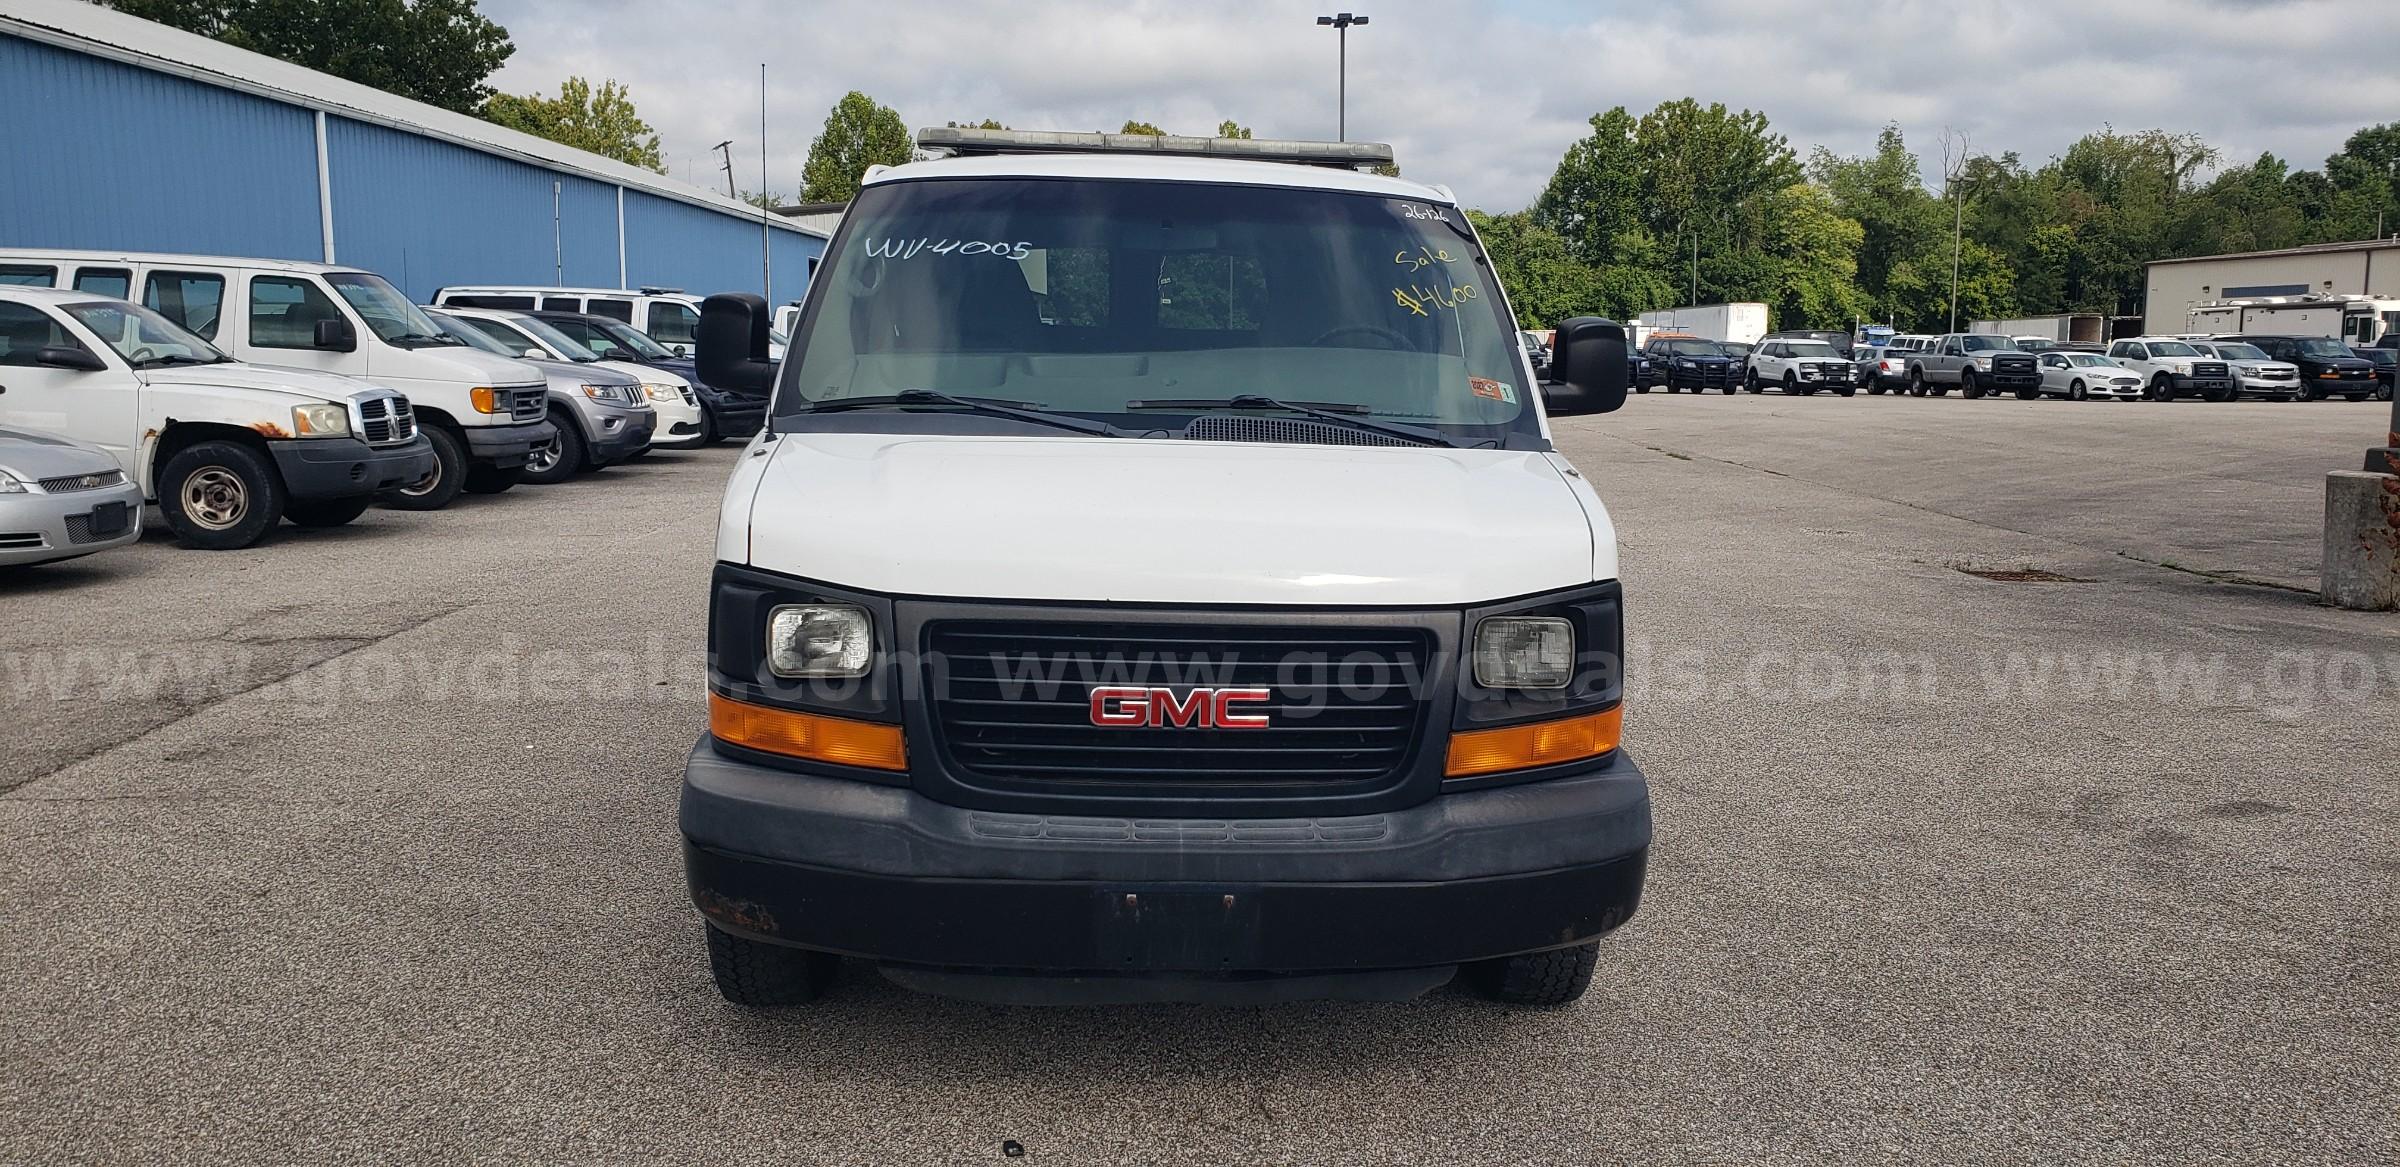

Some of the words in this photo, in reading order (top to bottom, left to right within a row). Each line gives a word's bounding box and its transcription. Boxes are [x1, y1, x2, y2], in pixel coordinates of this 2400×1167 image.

[865, 237, 1033, 260] WV-4005
[1395, 246, 1458, 273] Sale
[1090, 686, 1271, 729] GMC
